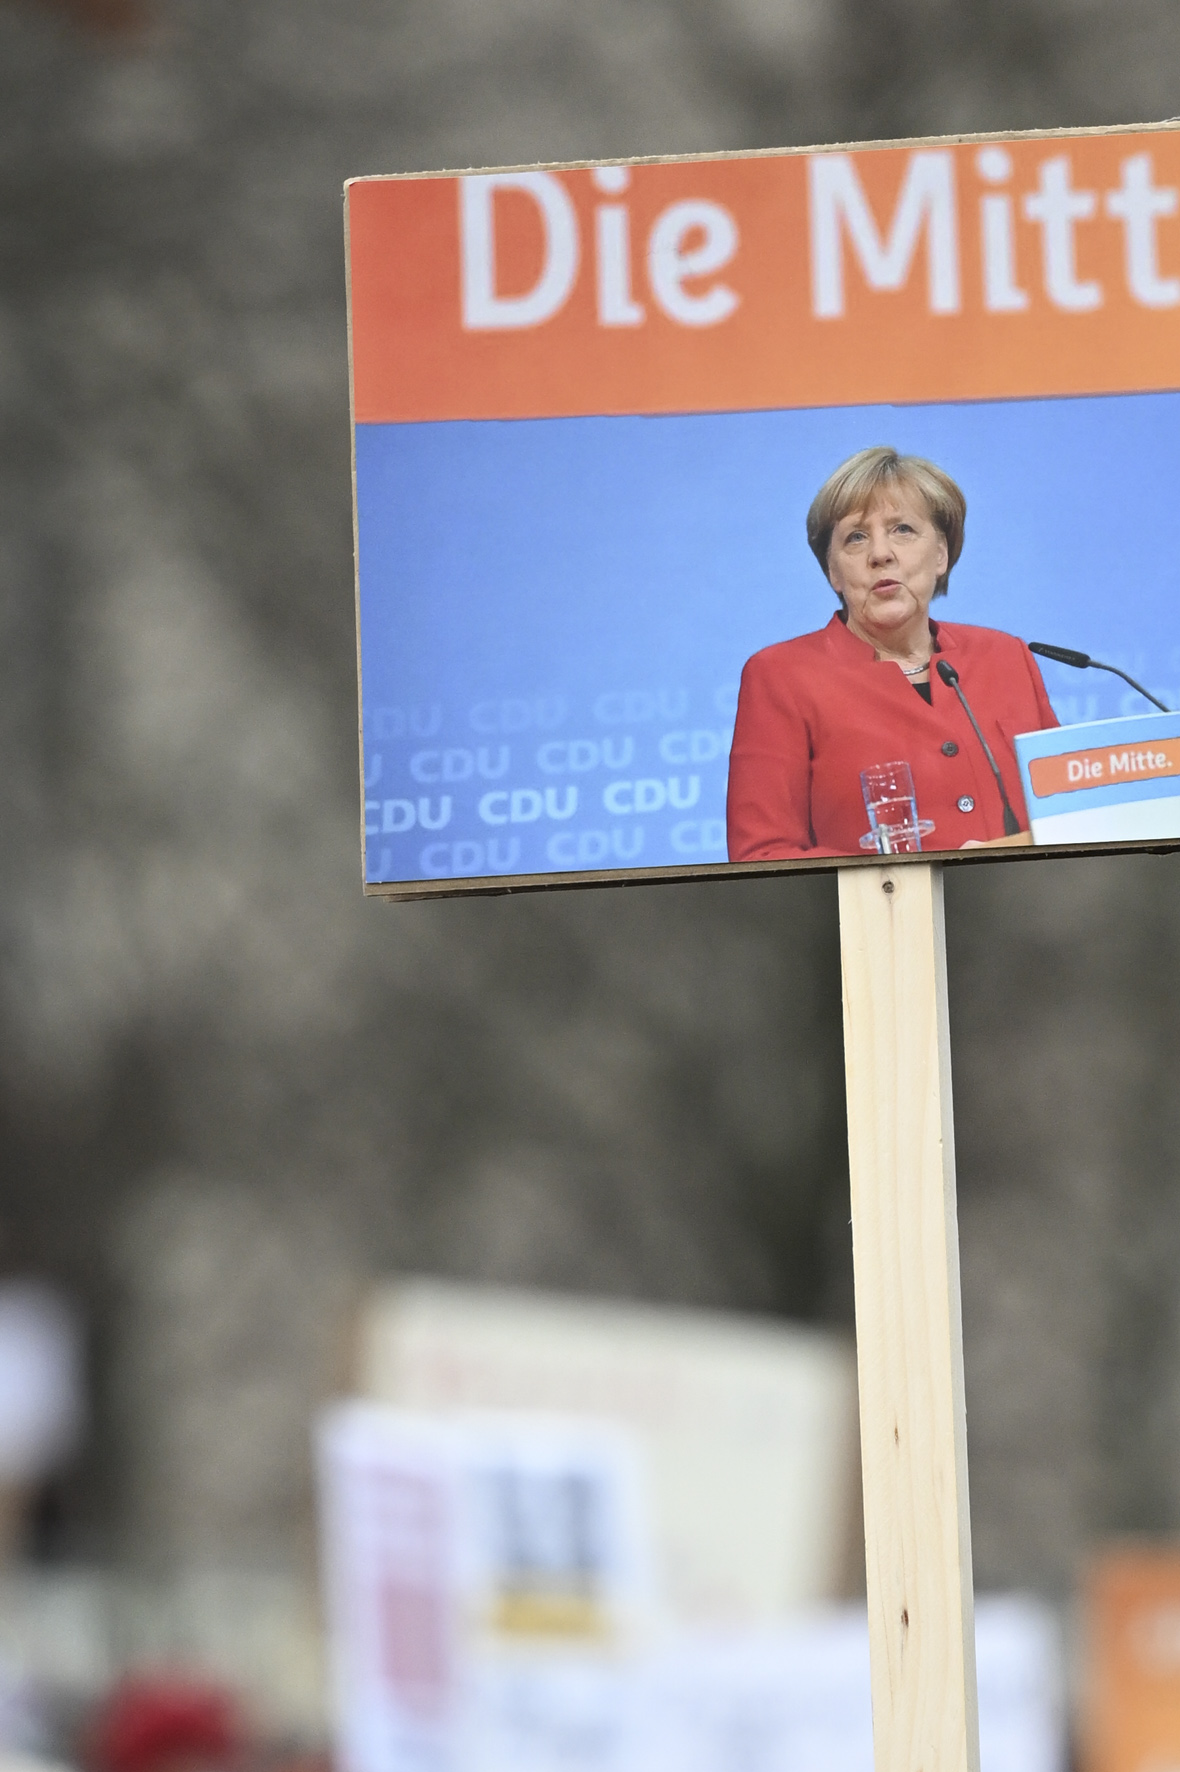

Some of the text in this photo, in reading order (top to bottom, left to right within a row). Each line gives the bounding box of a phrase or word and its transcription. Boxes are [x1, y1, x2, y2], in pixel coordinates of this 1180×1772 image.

[459, 167, 740, 330] Die
[409, 745, 511, 784] CDU
[537, 735, 635, 774] CDU
[1067, 749, 1173, 783] Die Mitte.
[478, 785, 578, 826] CDU
[603, 775, 701, 815] CDU
[419, 837, 521, 877] CDU
[547, 825, 645, 866] CDU
